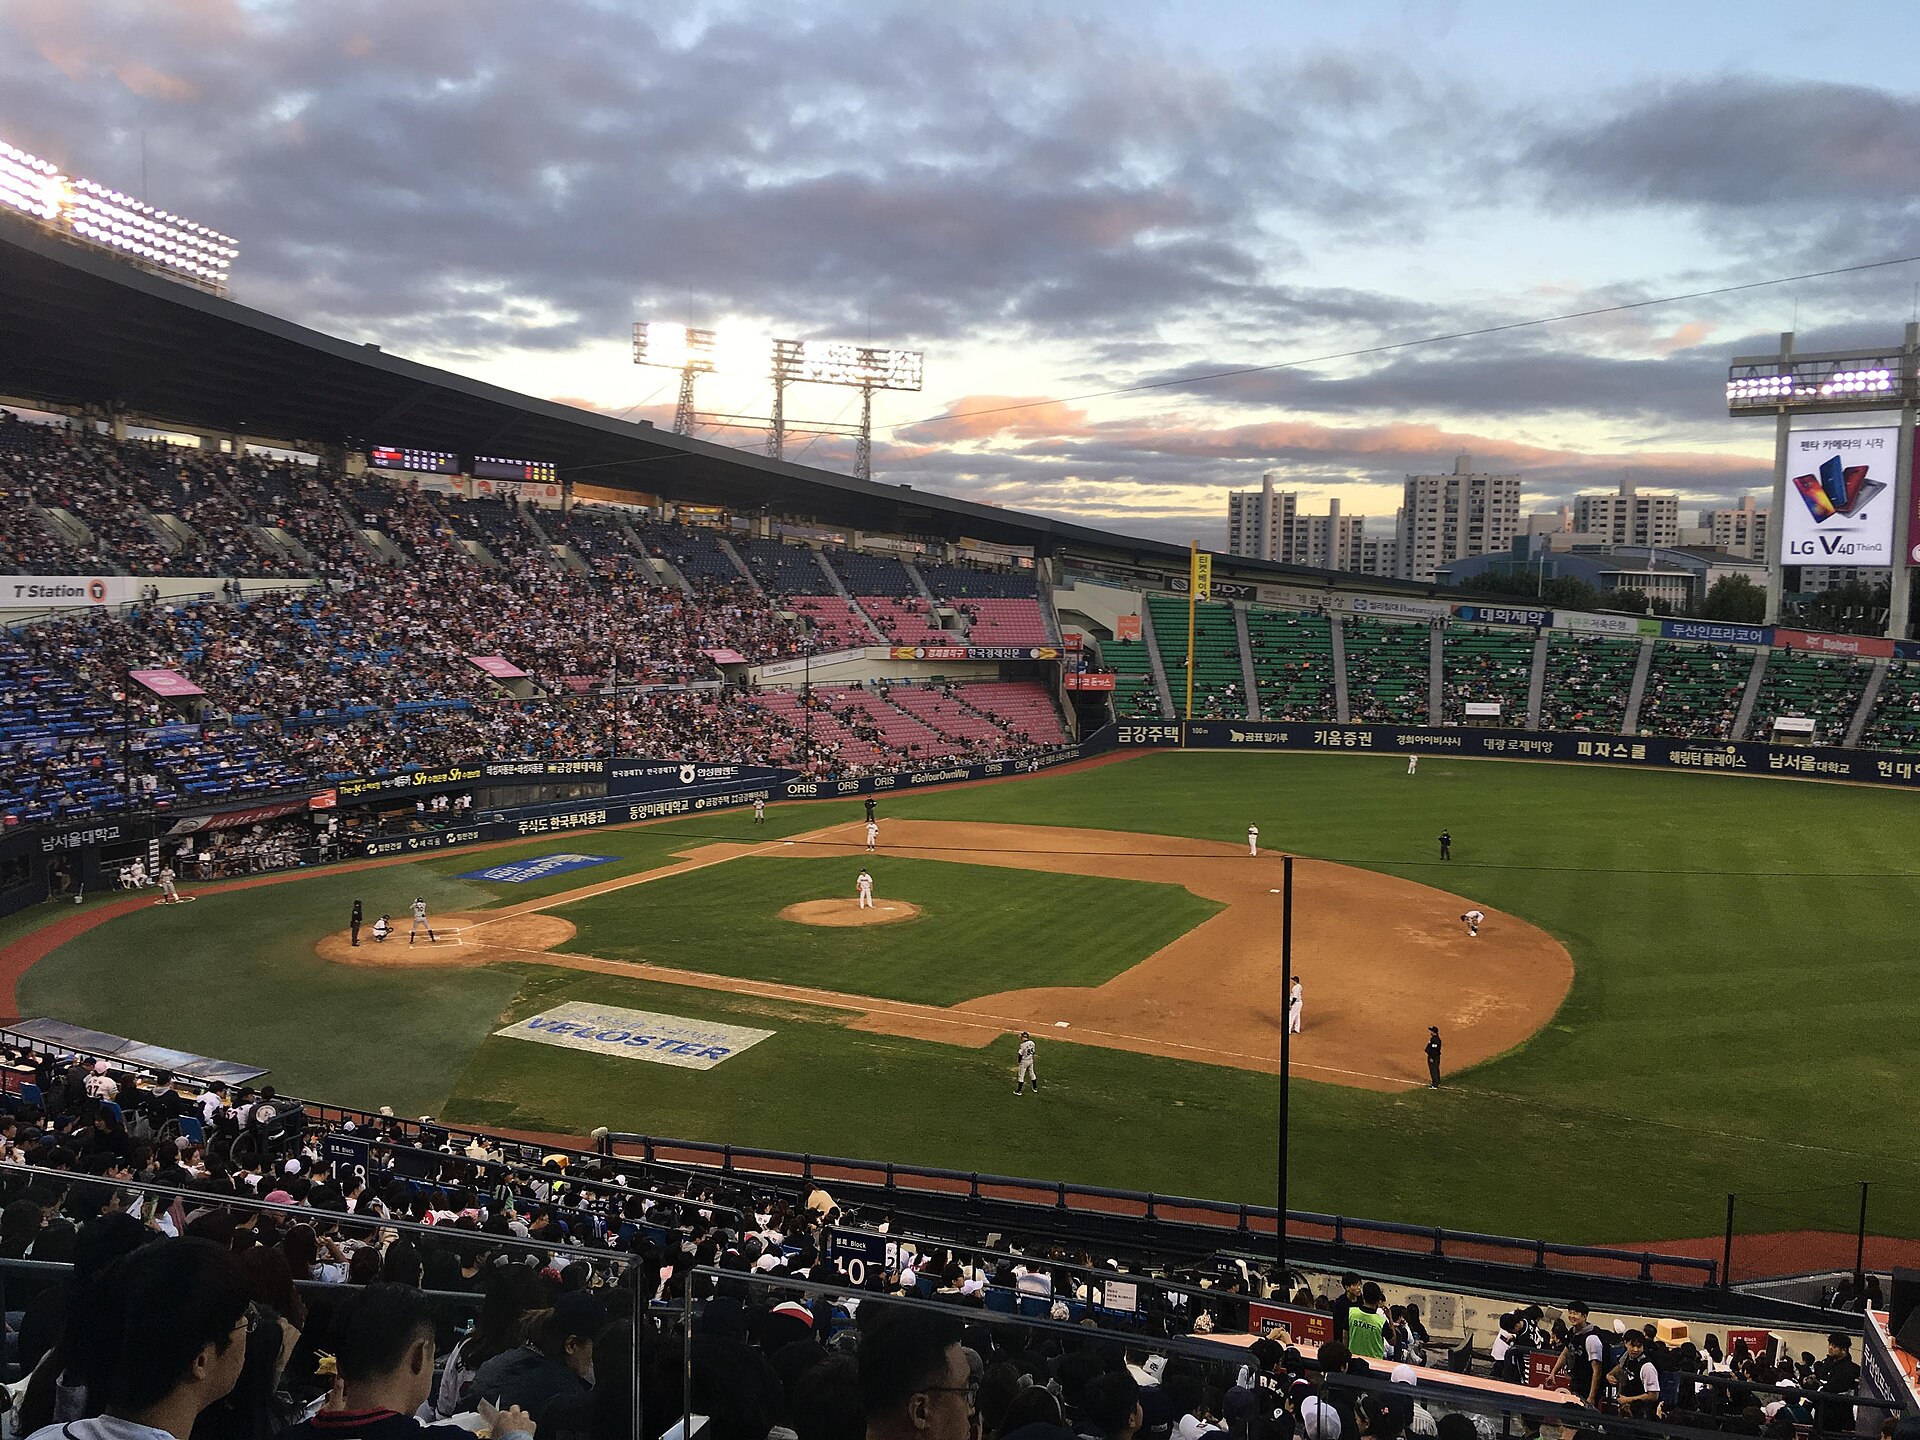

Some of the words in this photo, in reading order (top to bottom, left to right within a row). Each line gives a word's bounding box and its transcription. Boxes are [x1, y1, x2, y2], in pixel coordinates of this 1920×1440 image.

[1800, 440, 1820, 452] 펜타
[1822, 439, 1862, 451] 카메라의
[1865, 438, 1885, 449] 시작
[1791, 541, 1815, 555] LG
[1480, 607, 1545, 625] 대화제약
[1671, 624, 1763, 643] 두산인프라코어
[1823, 639, 1858, 652] Bobcat
[1118, 726, 1179, 743] 금강주택
[1314, 730, 1373, 747] 키움증권
[1577, 741, 1647, 761] 피자스쿨
[1702, 752, 1748, 768] 플레이스
[448, 768, 462, 781] Sh
[556, 761, 604, 774] 금강펜테리움
[985, 763, 1003, 773] ORIS
[412, 772, 427, 786] Sh
[874, 776, 895, 787] ORIS
[911, 770, 970, 784] #GoYourOwnWay
[787, 784, 818, 794] ORIS
[837, 780, 859, 792] ORIS
[629, 800, 689, 820] 동양미래대학교
[518, 818, 549, 834] 주식도
[549, 810, 607, 830] 한국투자증권
[41, 826, 121, 852] 남서울대학교
[527, 1016, 731, 1060] VELOSTER
[330, 1160, 366, 1189] 18
[850, 1240, 867, 1249] Block
[1352, 1320, 1377, 1333] STAFF
